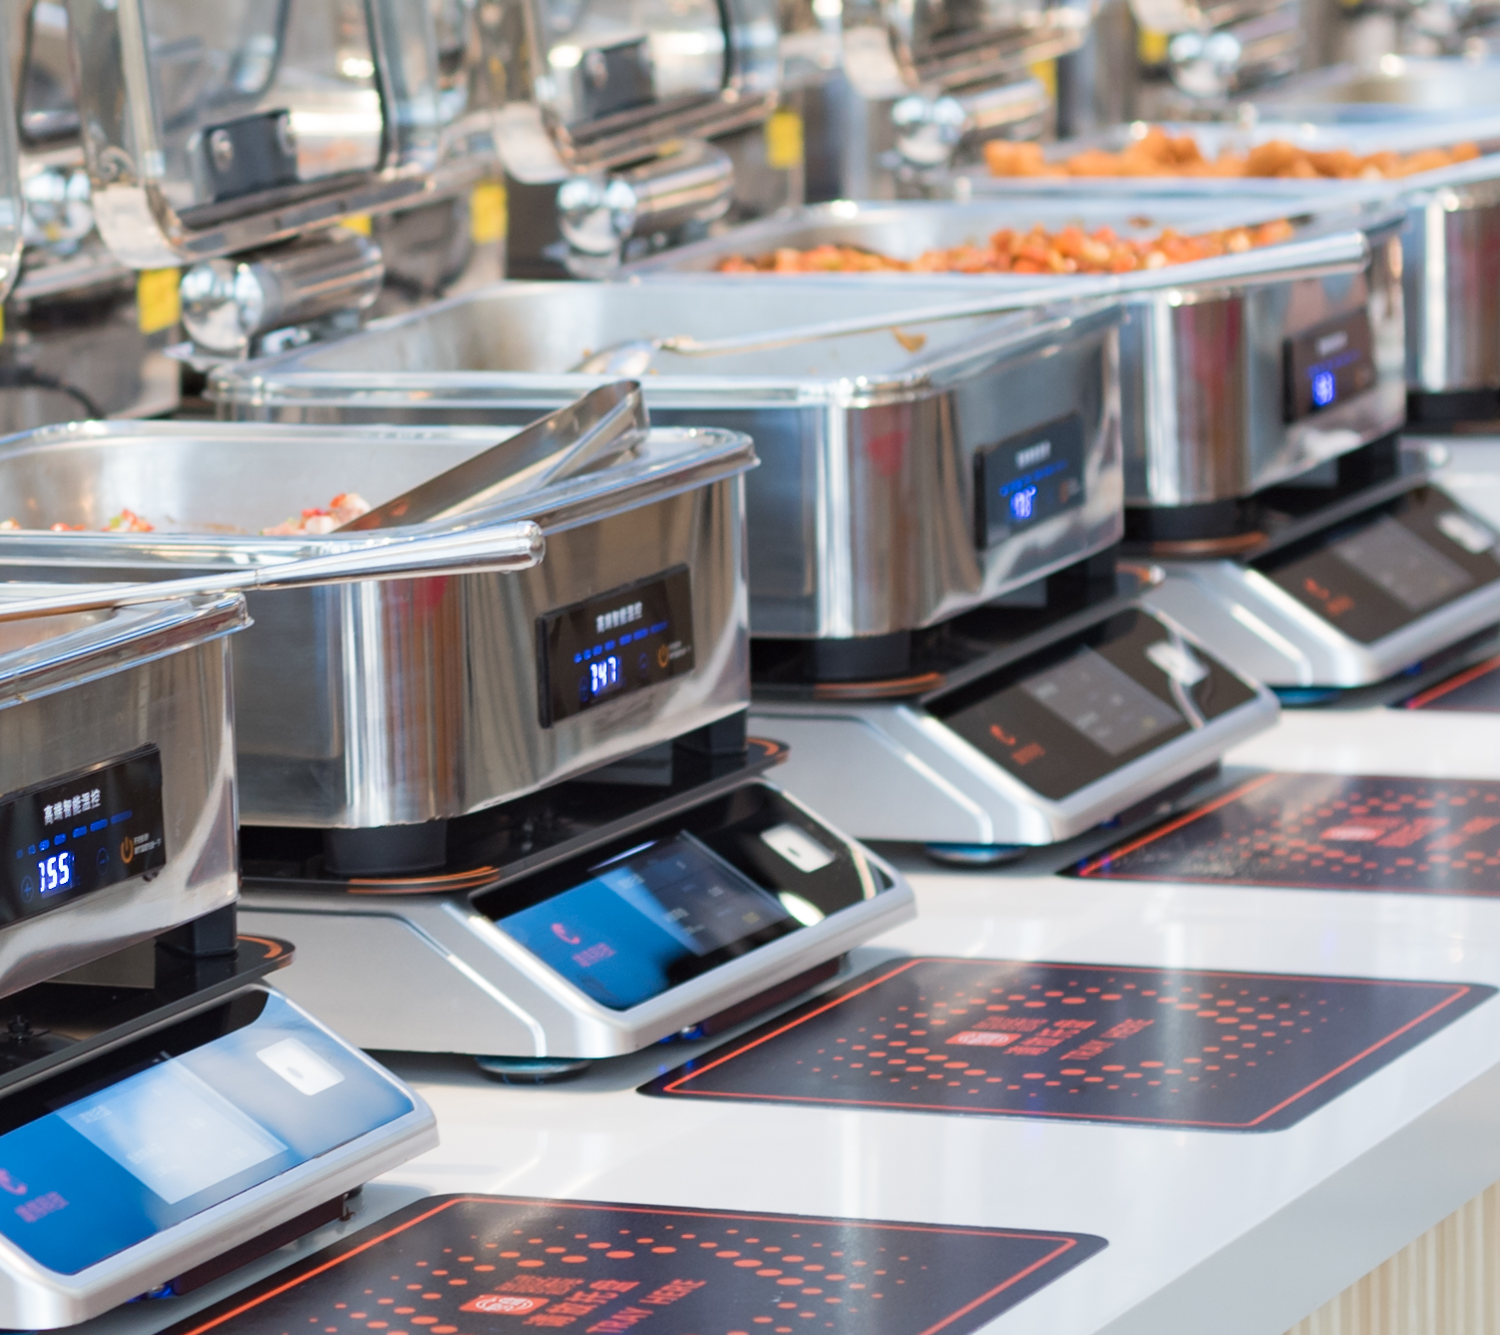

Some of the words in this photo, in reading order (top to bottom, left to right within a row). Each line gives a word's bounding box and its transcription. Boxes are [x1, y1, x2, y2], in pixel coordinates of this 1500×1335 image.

[43, 788, 101, 826] 高端智能温控
[522, 1279, 640, 1327] 请放托盘
[585, 1306, 654, 1334] TRAY
[639, 1278, 707, 1305] HERE
